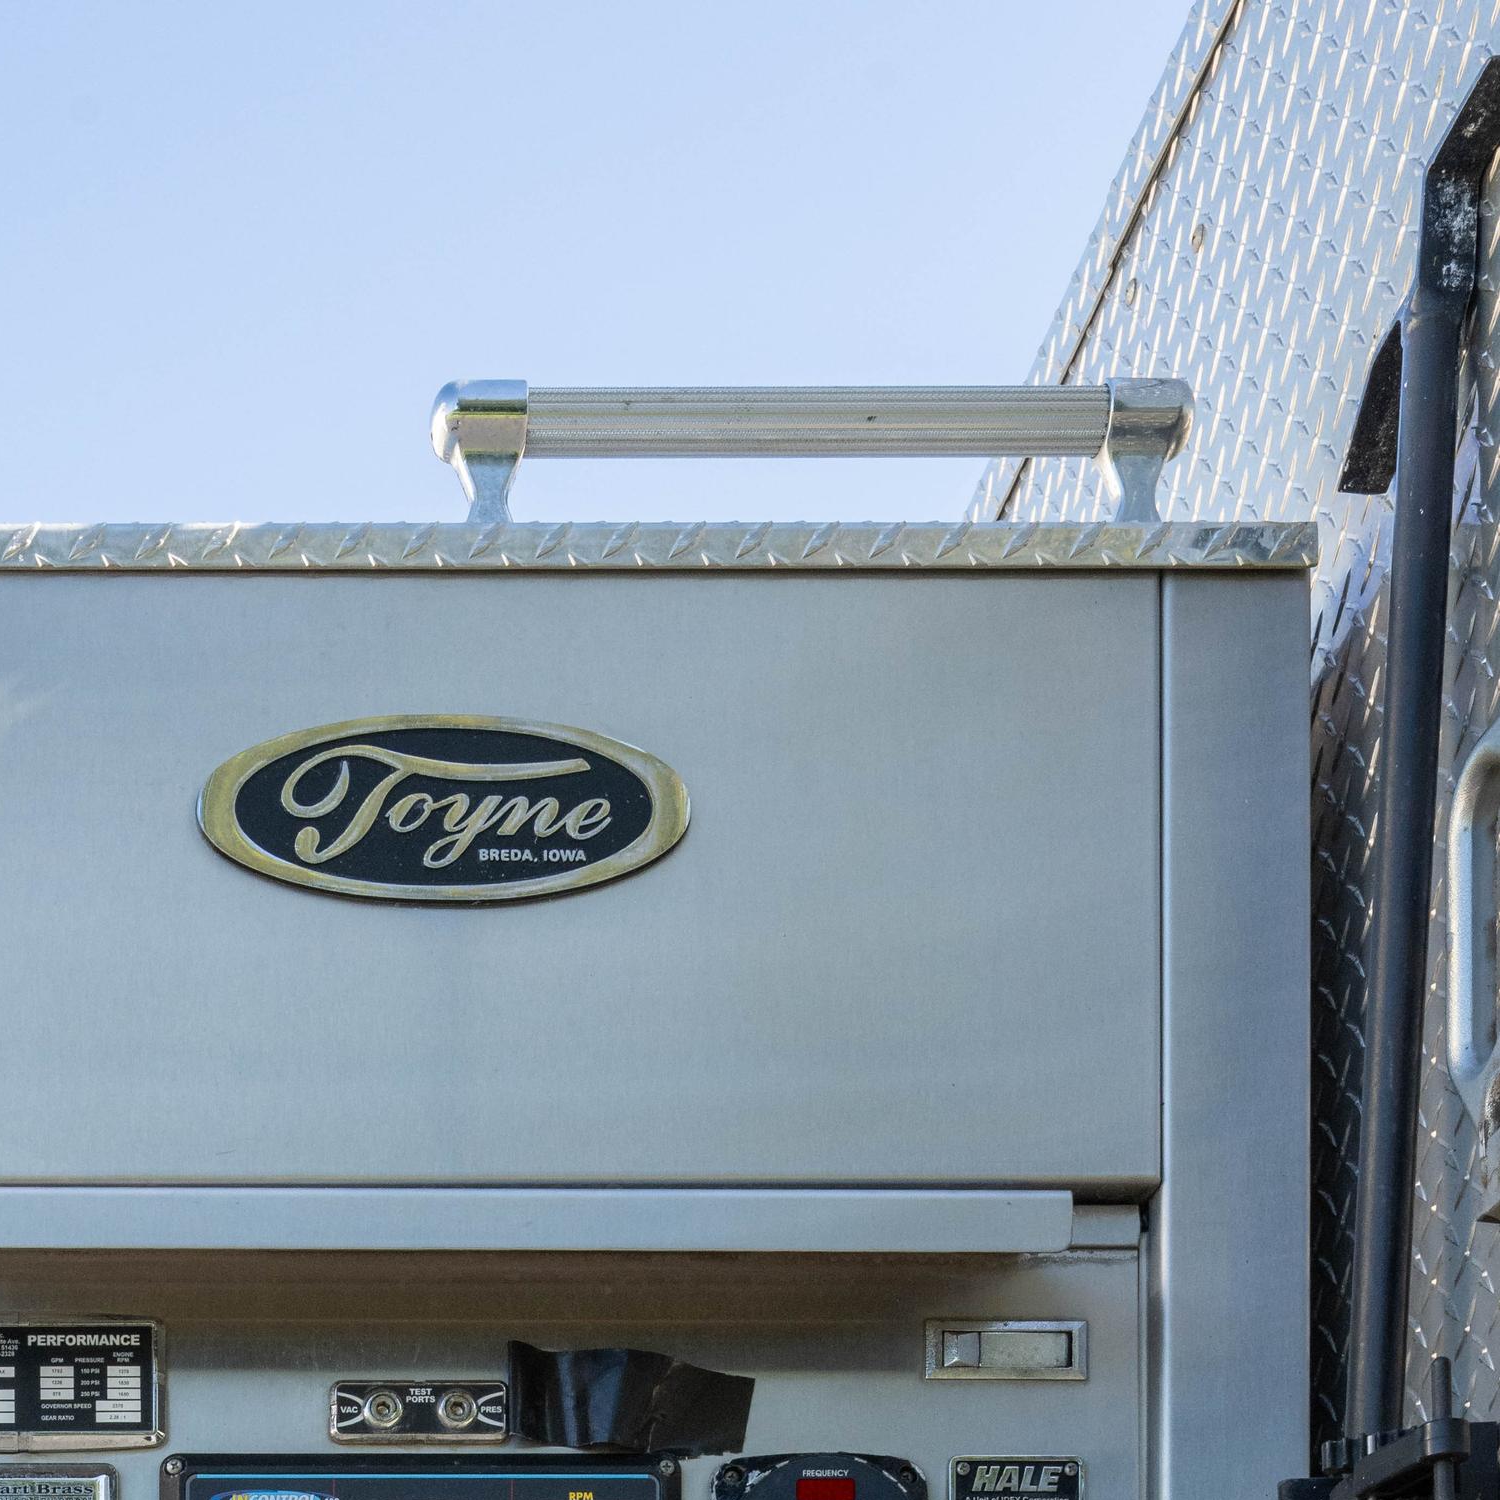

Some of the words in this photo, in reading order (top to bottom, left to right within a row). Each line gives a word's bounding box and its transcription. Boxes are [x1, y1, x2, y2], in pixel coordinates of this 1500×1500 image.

[282, 745, 613, 868] Toyne
[479, 849, 539, 863] BREDA,
[543, 848, 586, 862] IOWA
[27, 1334, 140, 1346] PERFORMANCE
[410, 1388, 431, 1396] TEST
[406, 1395, 435, 1403] PORTS
[340, 1406, 358, 1414] VAC
[480, 1406, 502, 1414] PRES
[972, 1466, 1063, 1492] HALE
[37, 1483, 93, 1494] Brass
[569, 1492, 593, 1500] RPM
